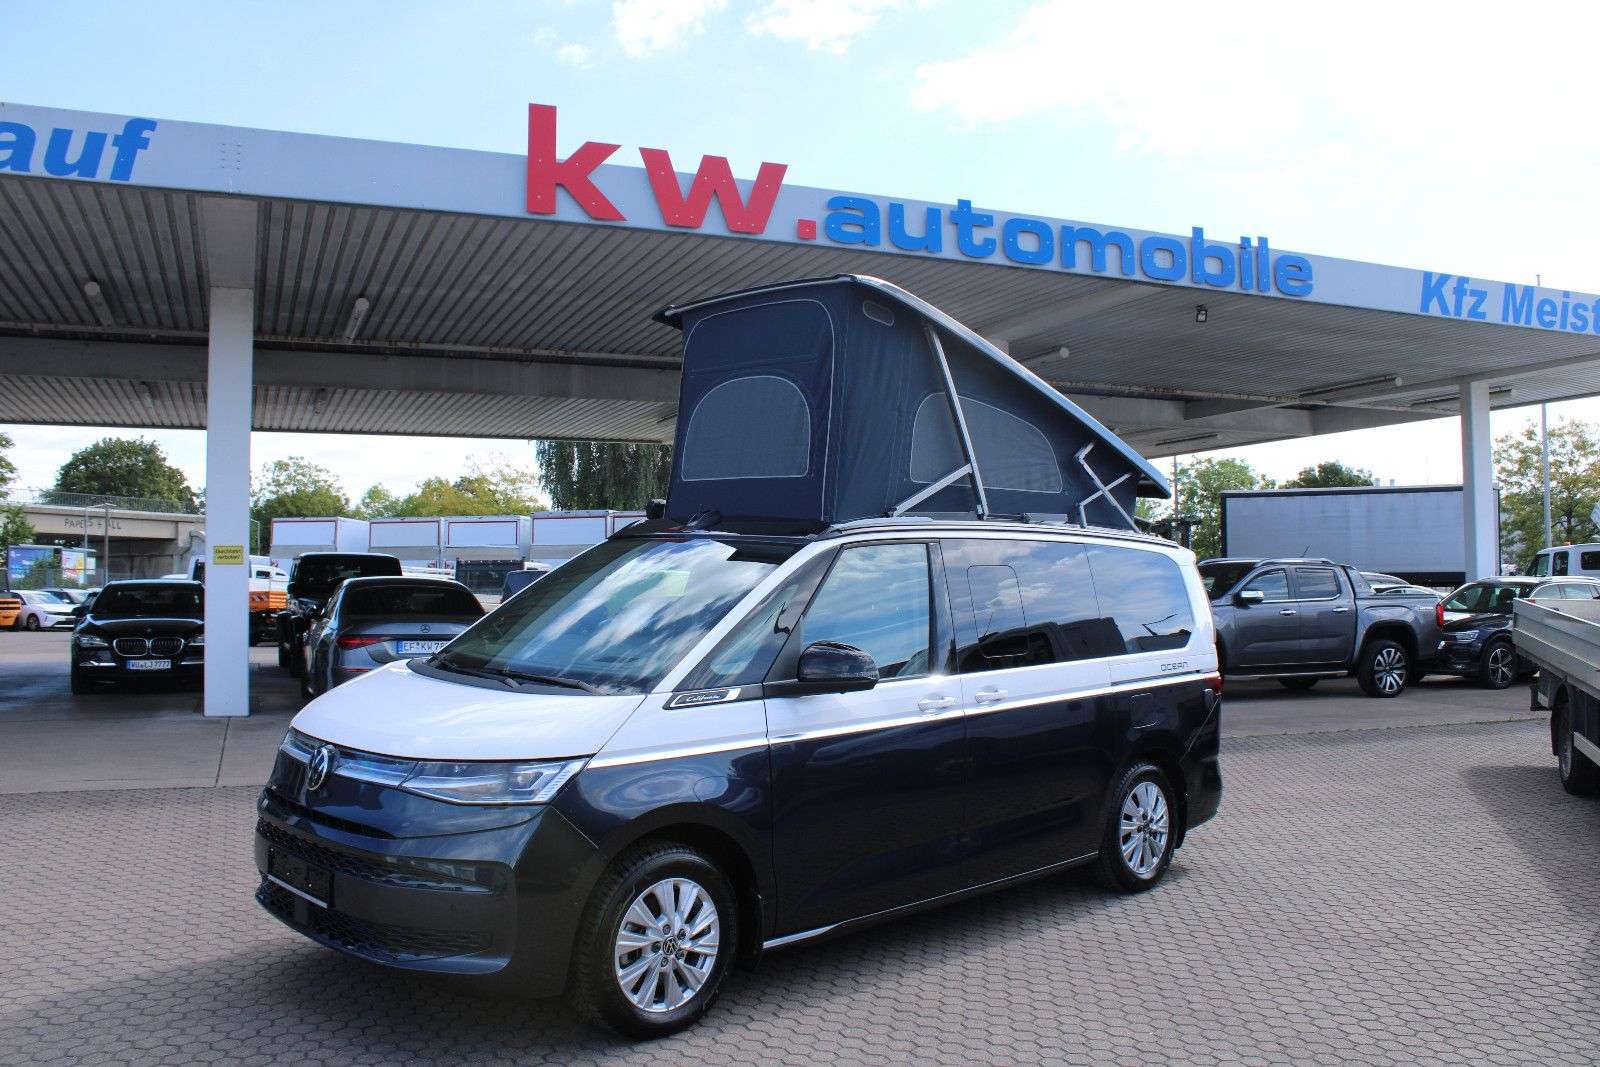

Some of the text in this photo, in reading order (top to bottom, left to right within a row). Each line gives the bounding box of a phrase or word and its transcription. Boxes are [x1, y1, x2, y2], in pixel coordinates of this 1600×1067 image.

[0, 118, 157, 181] auf
[1420, 271, 1488, 320] Kfz
[1161, 661, 1188, 671] OCEAN
